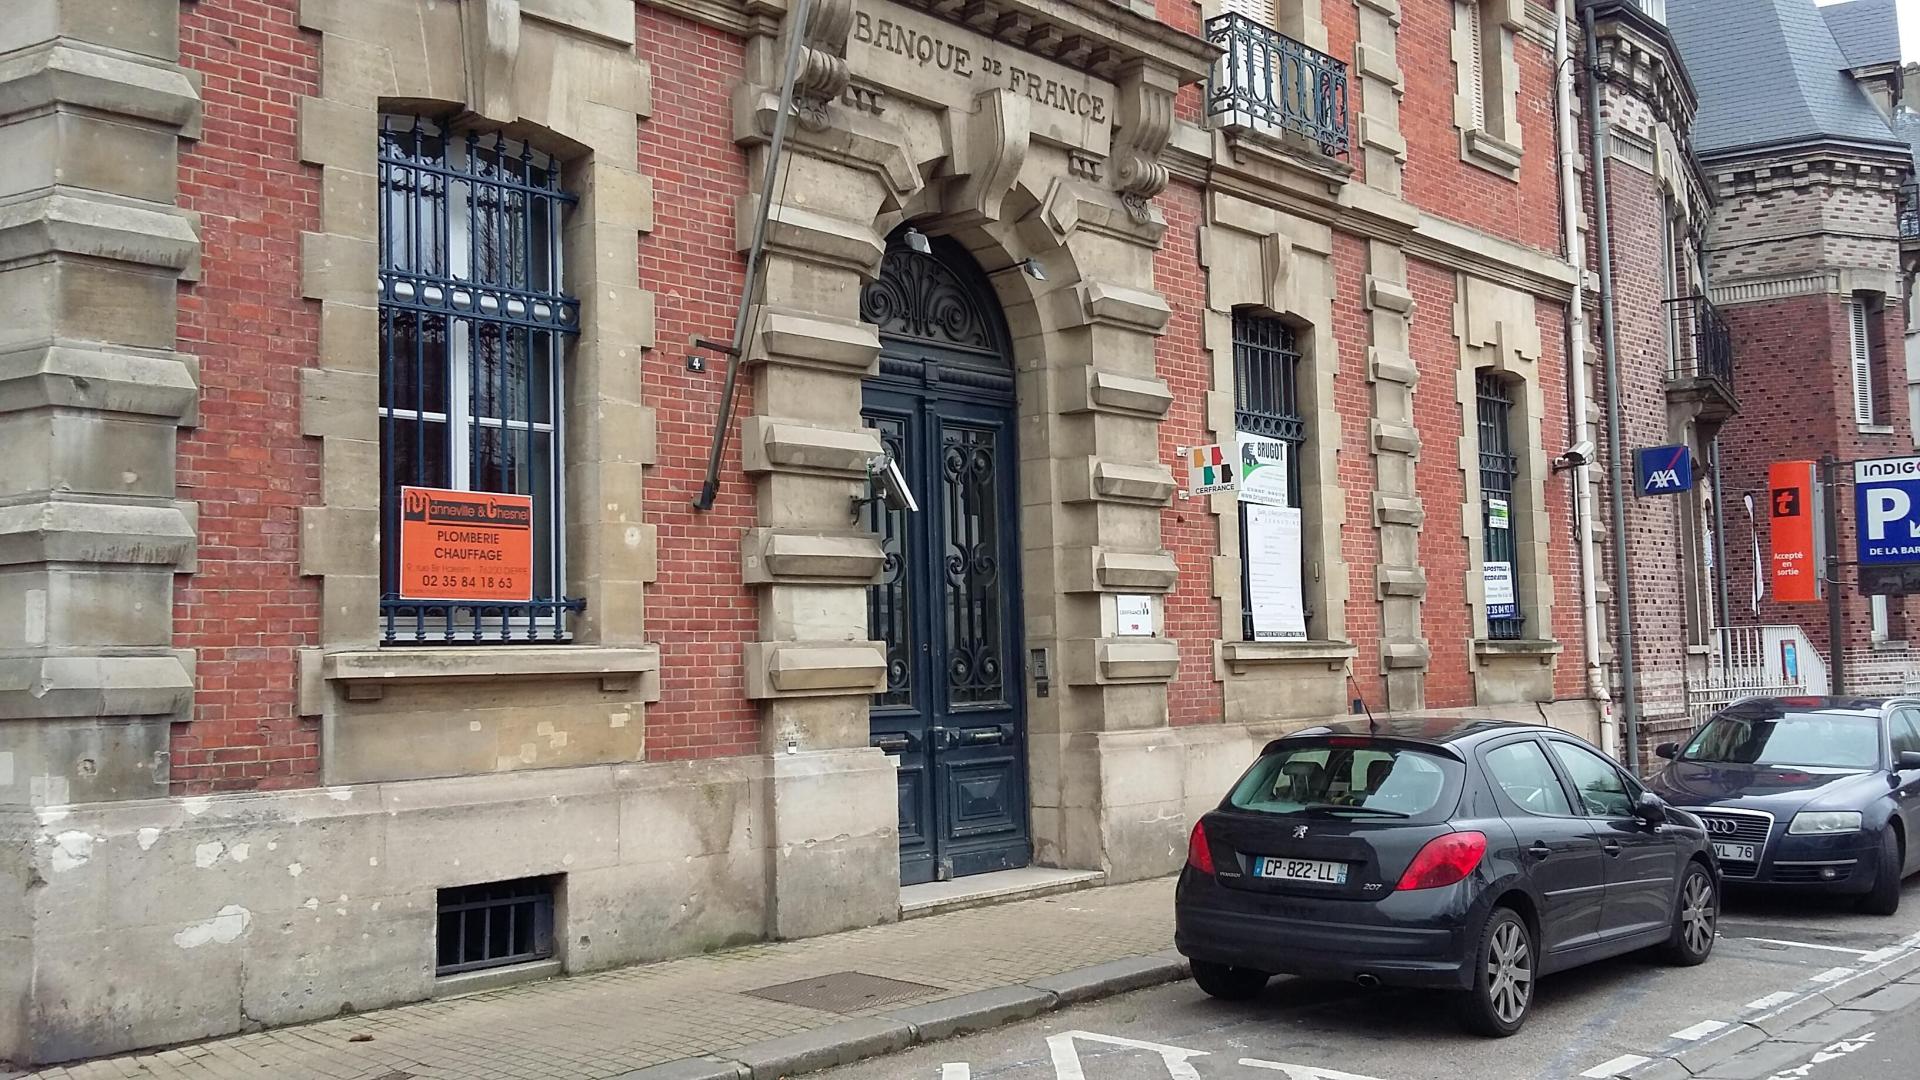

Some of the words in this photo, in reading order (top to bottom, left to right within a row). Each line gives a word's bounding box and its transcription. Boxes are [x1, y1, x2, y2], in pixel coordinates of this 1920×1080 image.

[854, 10, 973, 79] BANQUE
[982, 56, 1002, 76] DE
[1008, 66, 1106, 125] FRANCE
[692, 357, 701, 370] 4
[1257, 441, 1284, 461] BRUGOT
[1864, 462, 1920, 476] INDIG
[1645, 469, 1680, 490] AXA
[1195, 483, 1235, 495] CERFRANCE
[405, 491, 475, 524] Manneville
[478, 506, 486, 517] &
[487, 498, 529, 521] Chesnel
[1867, 488, 1910, 539] P
[437, 530, 500, 544] PLOMBERIE
[434, 547, 503, 561] CHAUFFAGE
[1774, 551, 1804, 561] Accepté
[1869, 547, 1883, 556] DE
[1885, 547, 1899, 555] LA
[1777, 567, 1800, 576] sortie
[422, 575, 438, 587] 02
[442, 576, 457, 588] 35
[461, 576, 475, 588] 84
[481, 577, 494, 588] 18
[498, 577, 513, 589] 63
[1715, 845, 1730, 857] YL
[1736, 846, 1752, 858] 76
[1265, 859, 1335, 881] CP-822-LL
[1336, 874, 1346, 883] 76
[1363, 883, 1383, 891] 207
